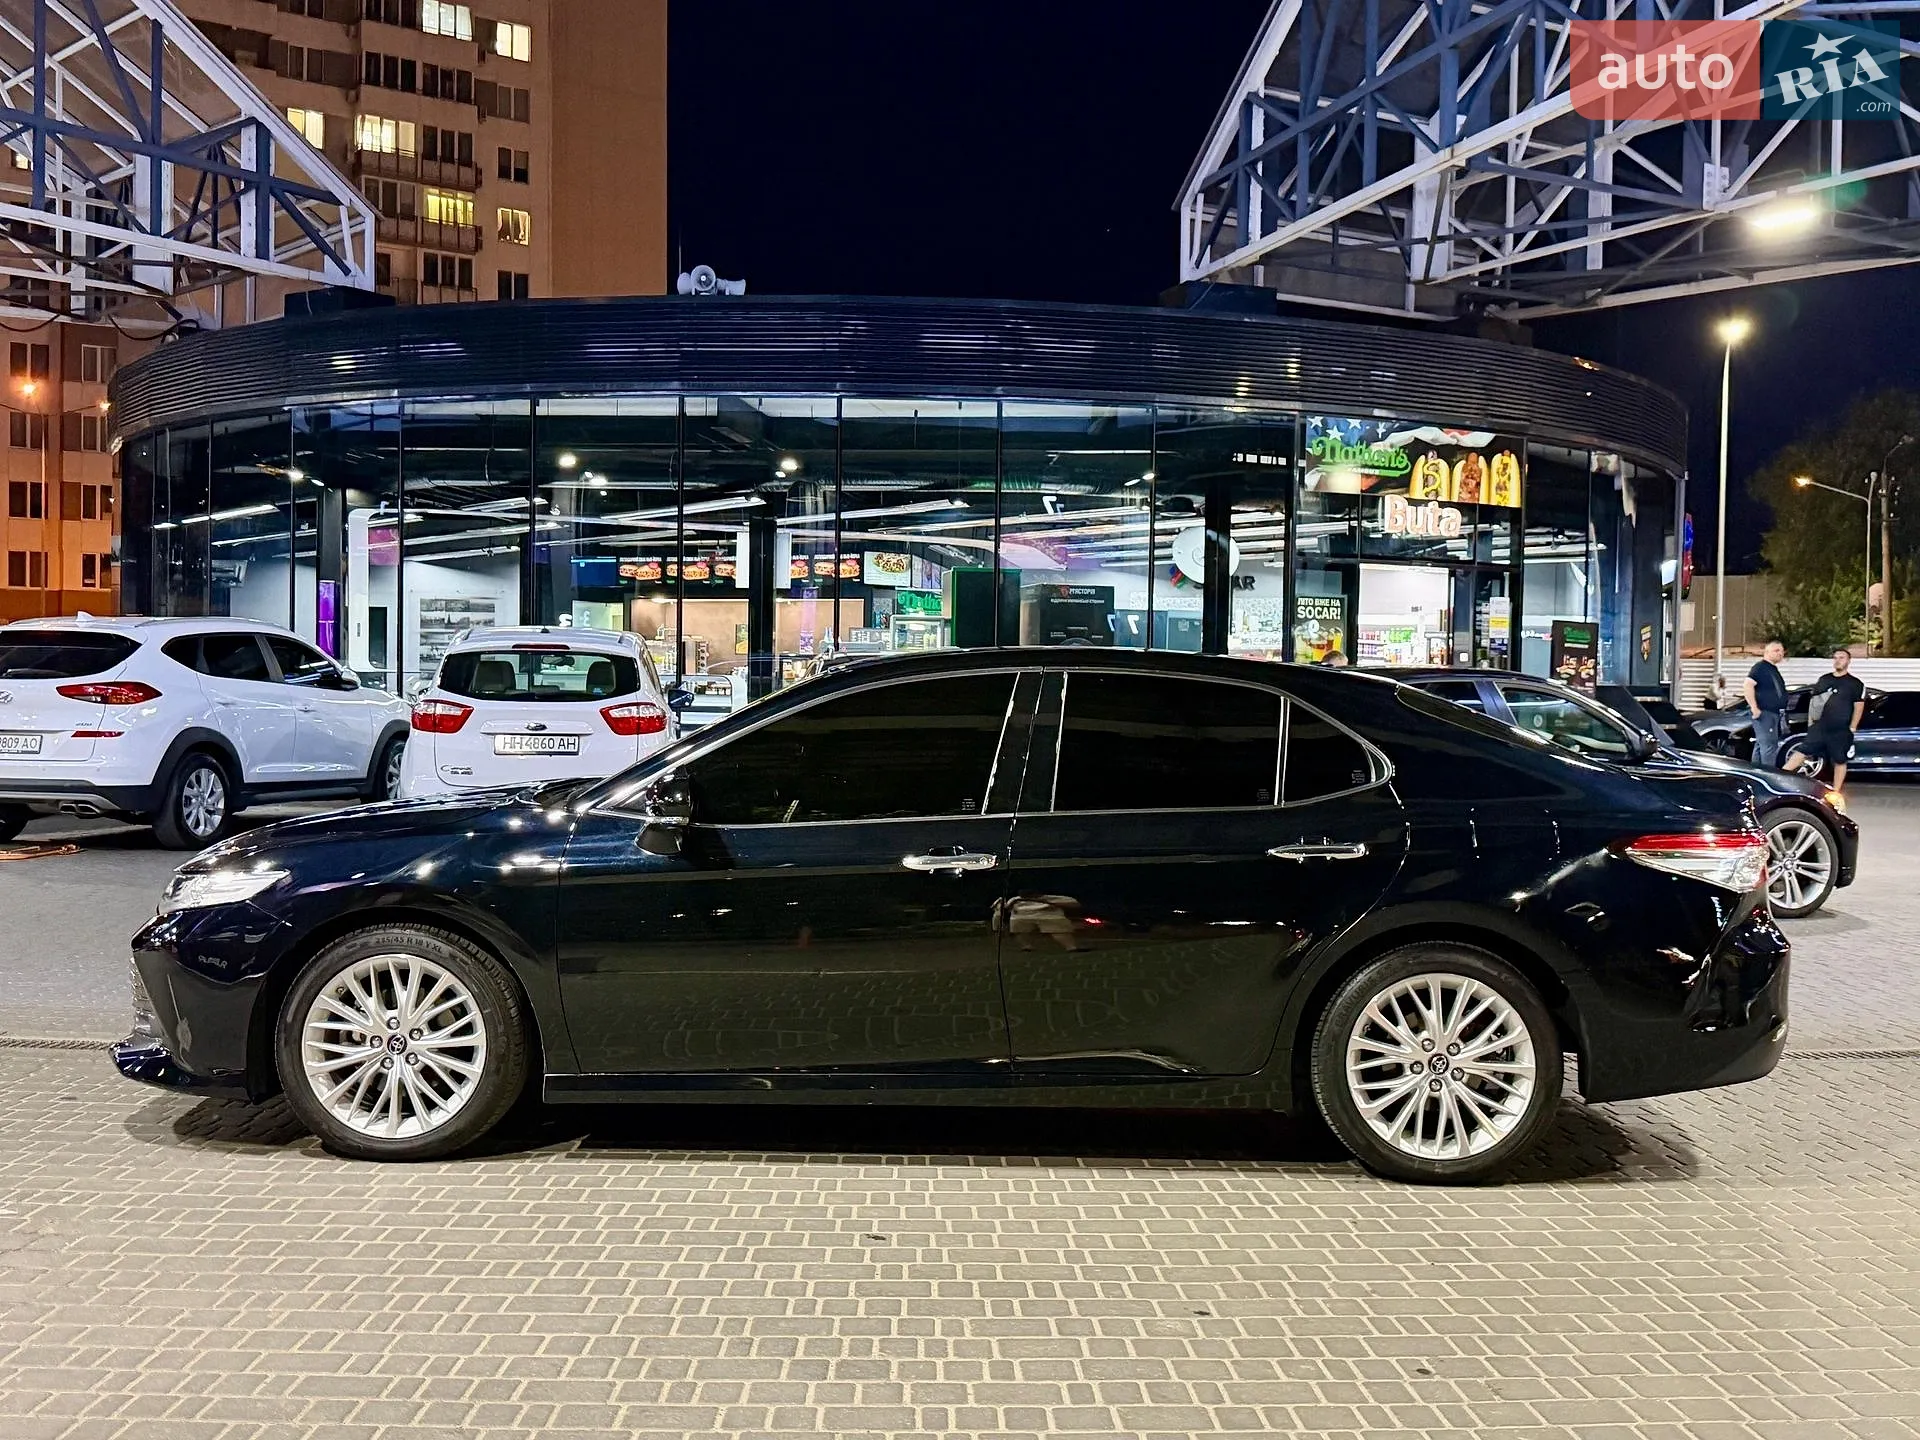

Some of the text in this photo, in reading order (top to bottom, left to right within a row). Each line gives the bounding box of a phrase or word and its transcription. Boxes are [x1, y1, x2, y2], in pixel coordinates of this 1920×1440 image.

[1384, 494, 1462, 537] Buta
[1297, 606, 1341, 620] SOCAR!
[524, 737, 555, 750] 4860
[557, 738, 576, 750] AH
